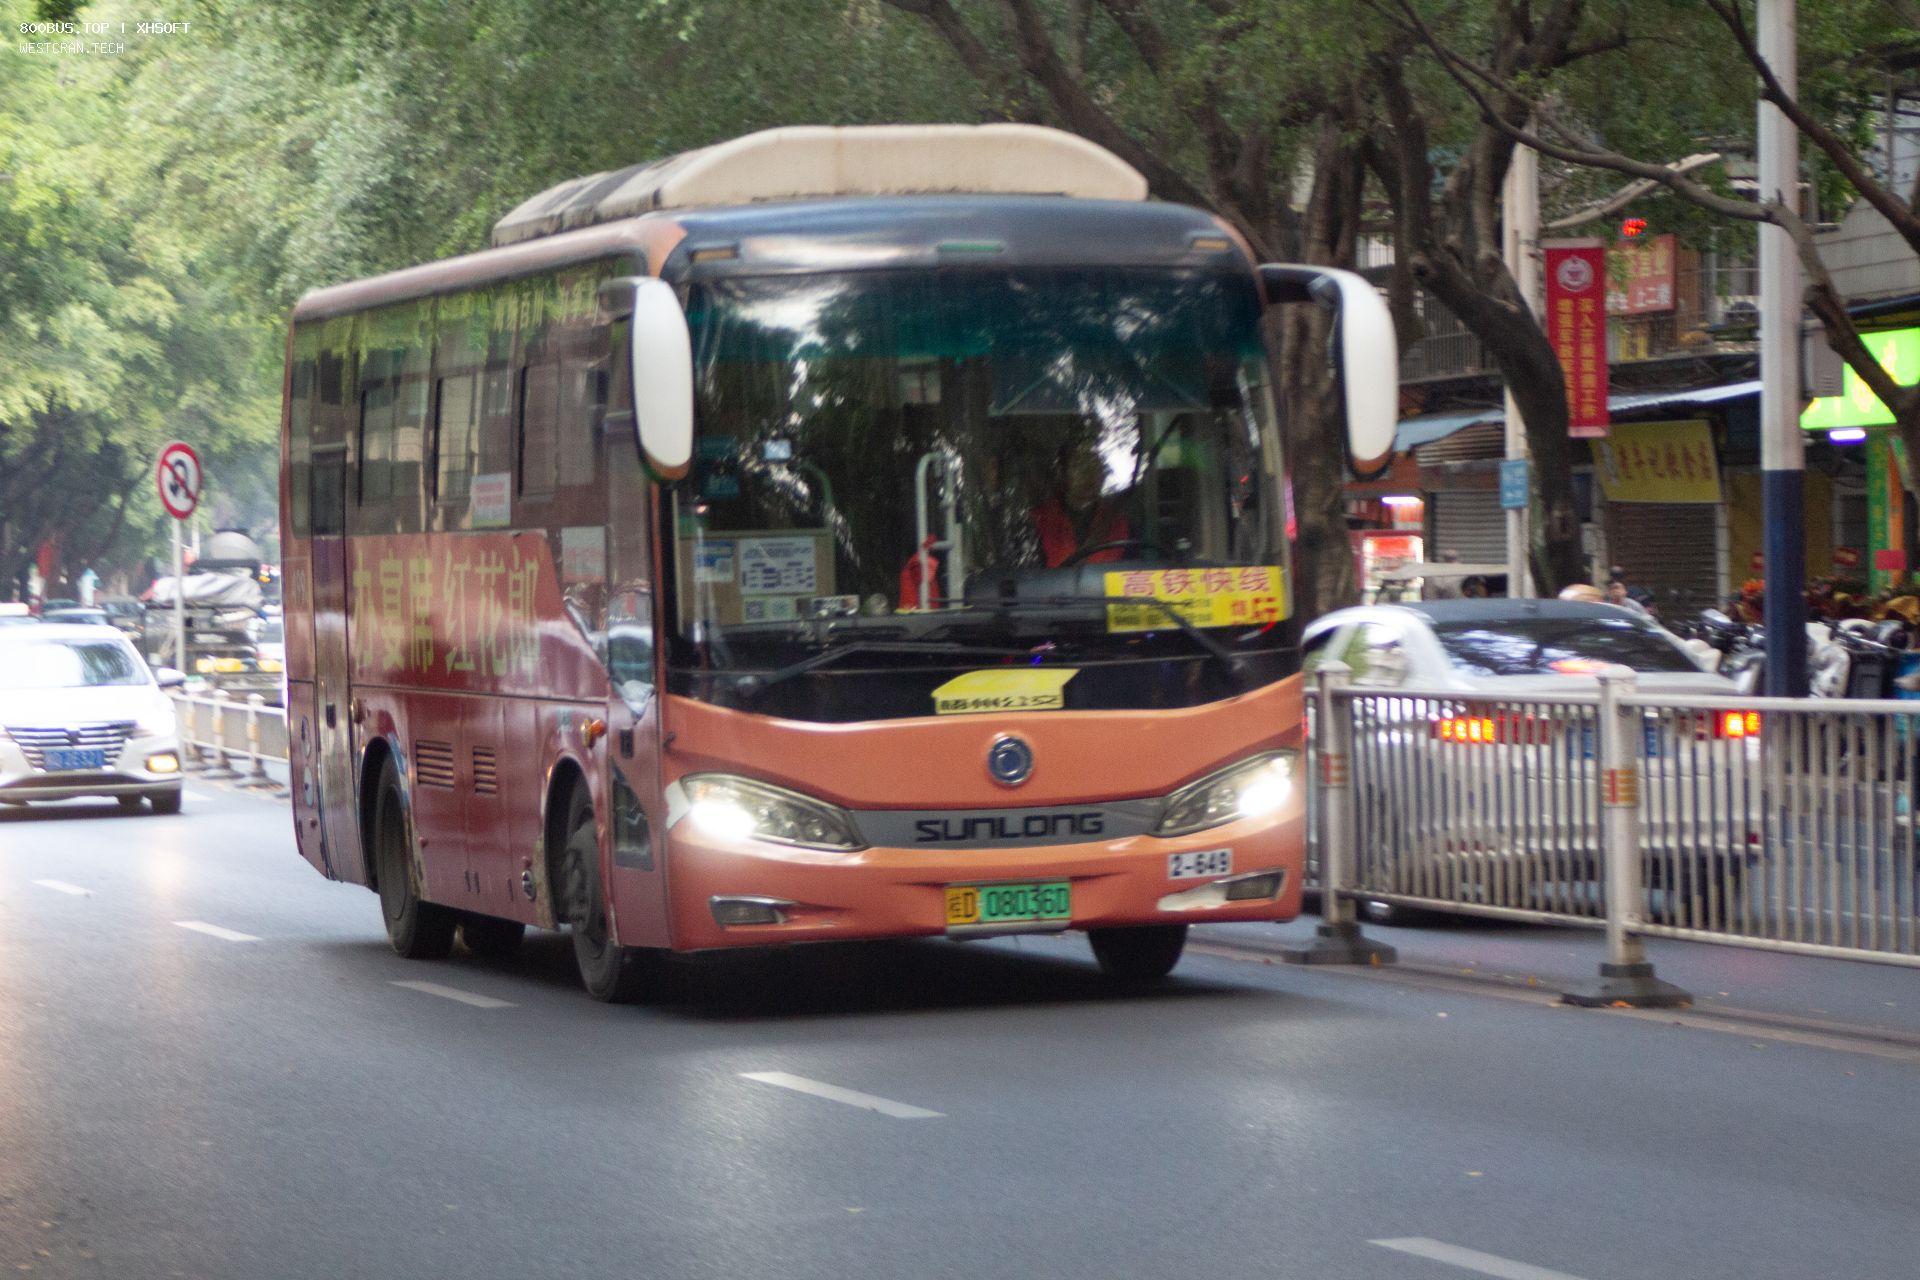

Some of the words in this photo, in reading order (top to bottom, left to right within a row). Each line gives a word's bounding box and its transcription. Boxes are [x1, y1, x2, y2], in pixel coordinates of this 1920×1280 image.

[1120, 566, 1271, 598] 高铁快线
[352, 549, 434, 676] 办宴席
[444, 545, 541, 684] 红花郎
[915, 812, 1105, 842] SUNLONG
[1171, 851, 1229, 877] 2-649
